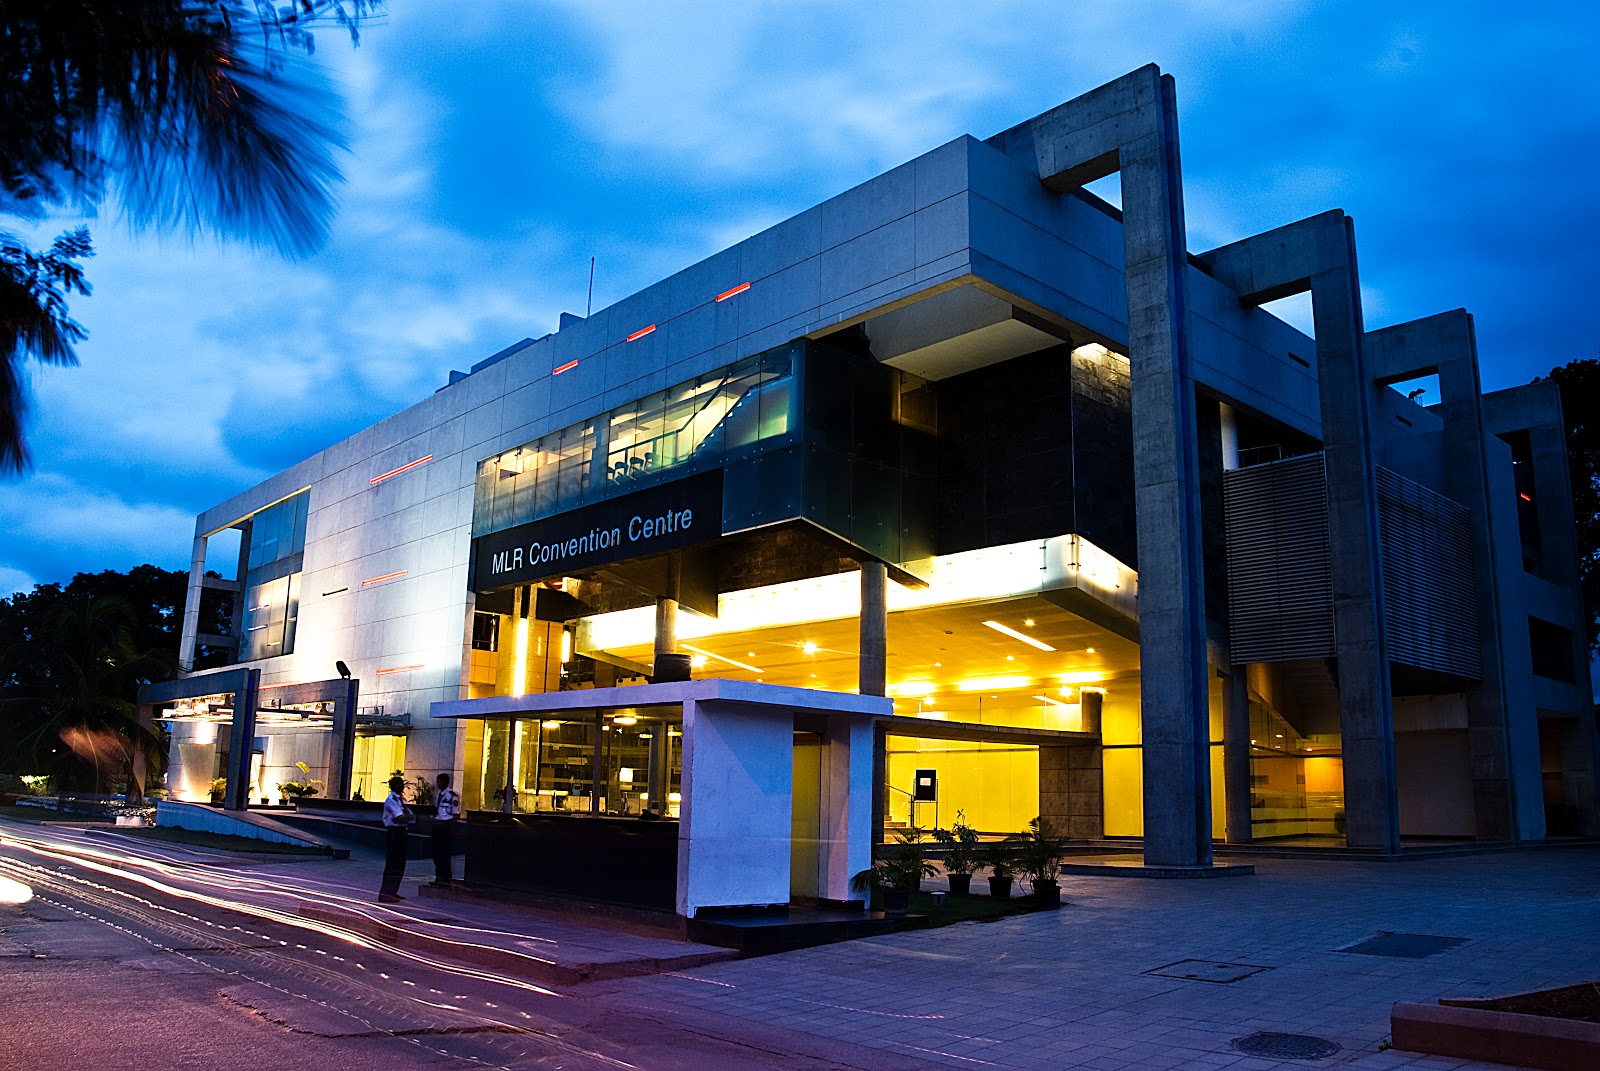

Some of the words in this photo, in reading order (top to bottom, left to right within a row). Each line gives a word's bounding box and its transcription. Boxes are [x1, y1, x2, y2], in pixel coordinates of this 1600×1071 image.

[491, 547, 523, 575] MLR
[529, 527, 620, 565] Convention
[628, 508, 693, 542] Centre
